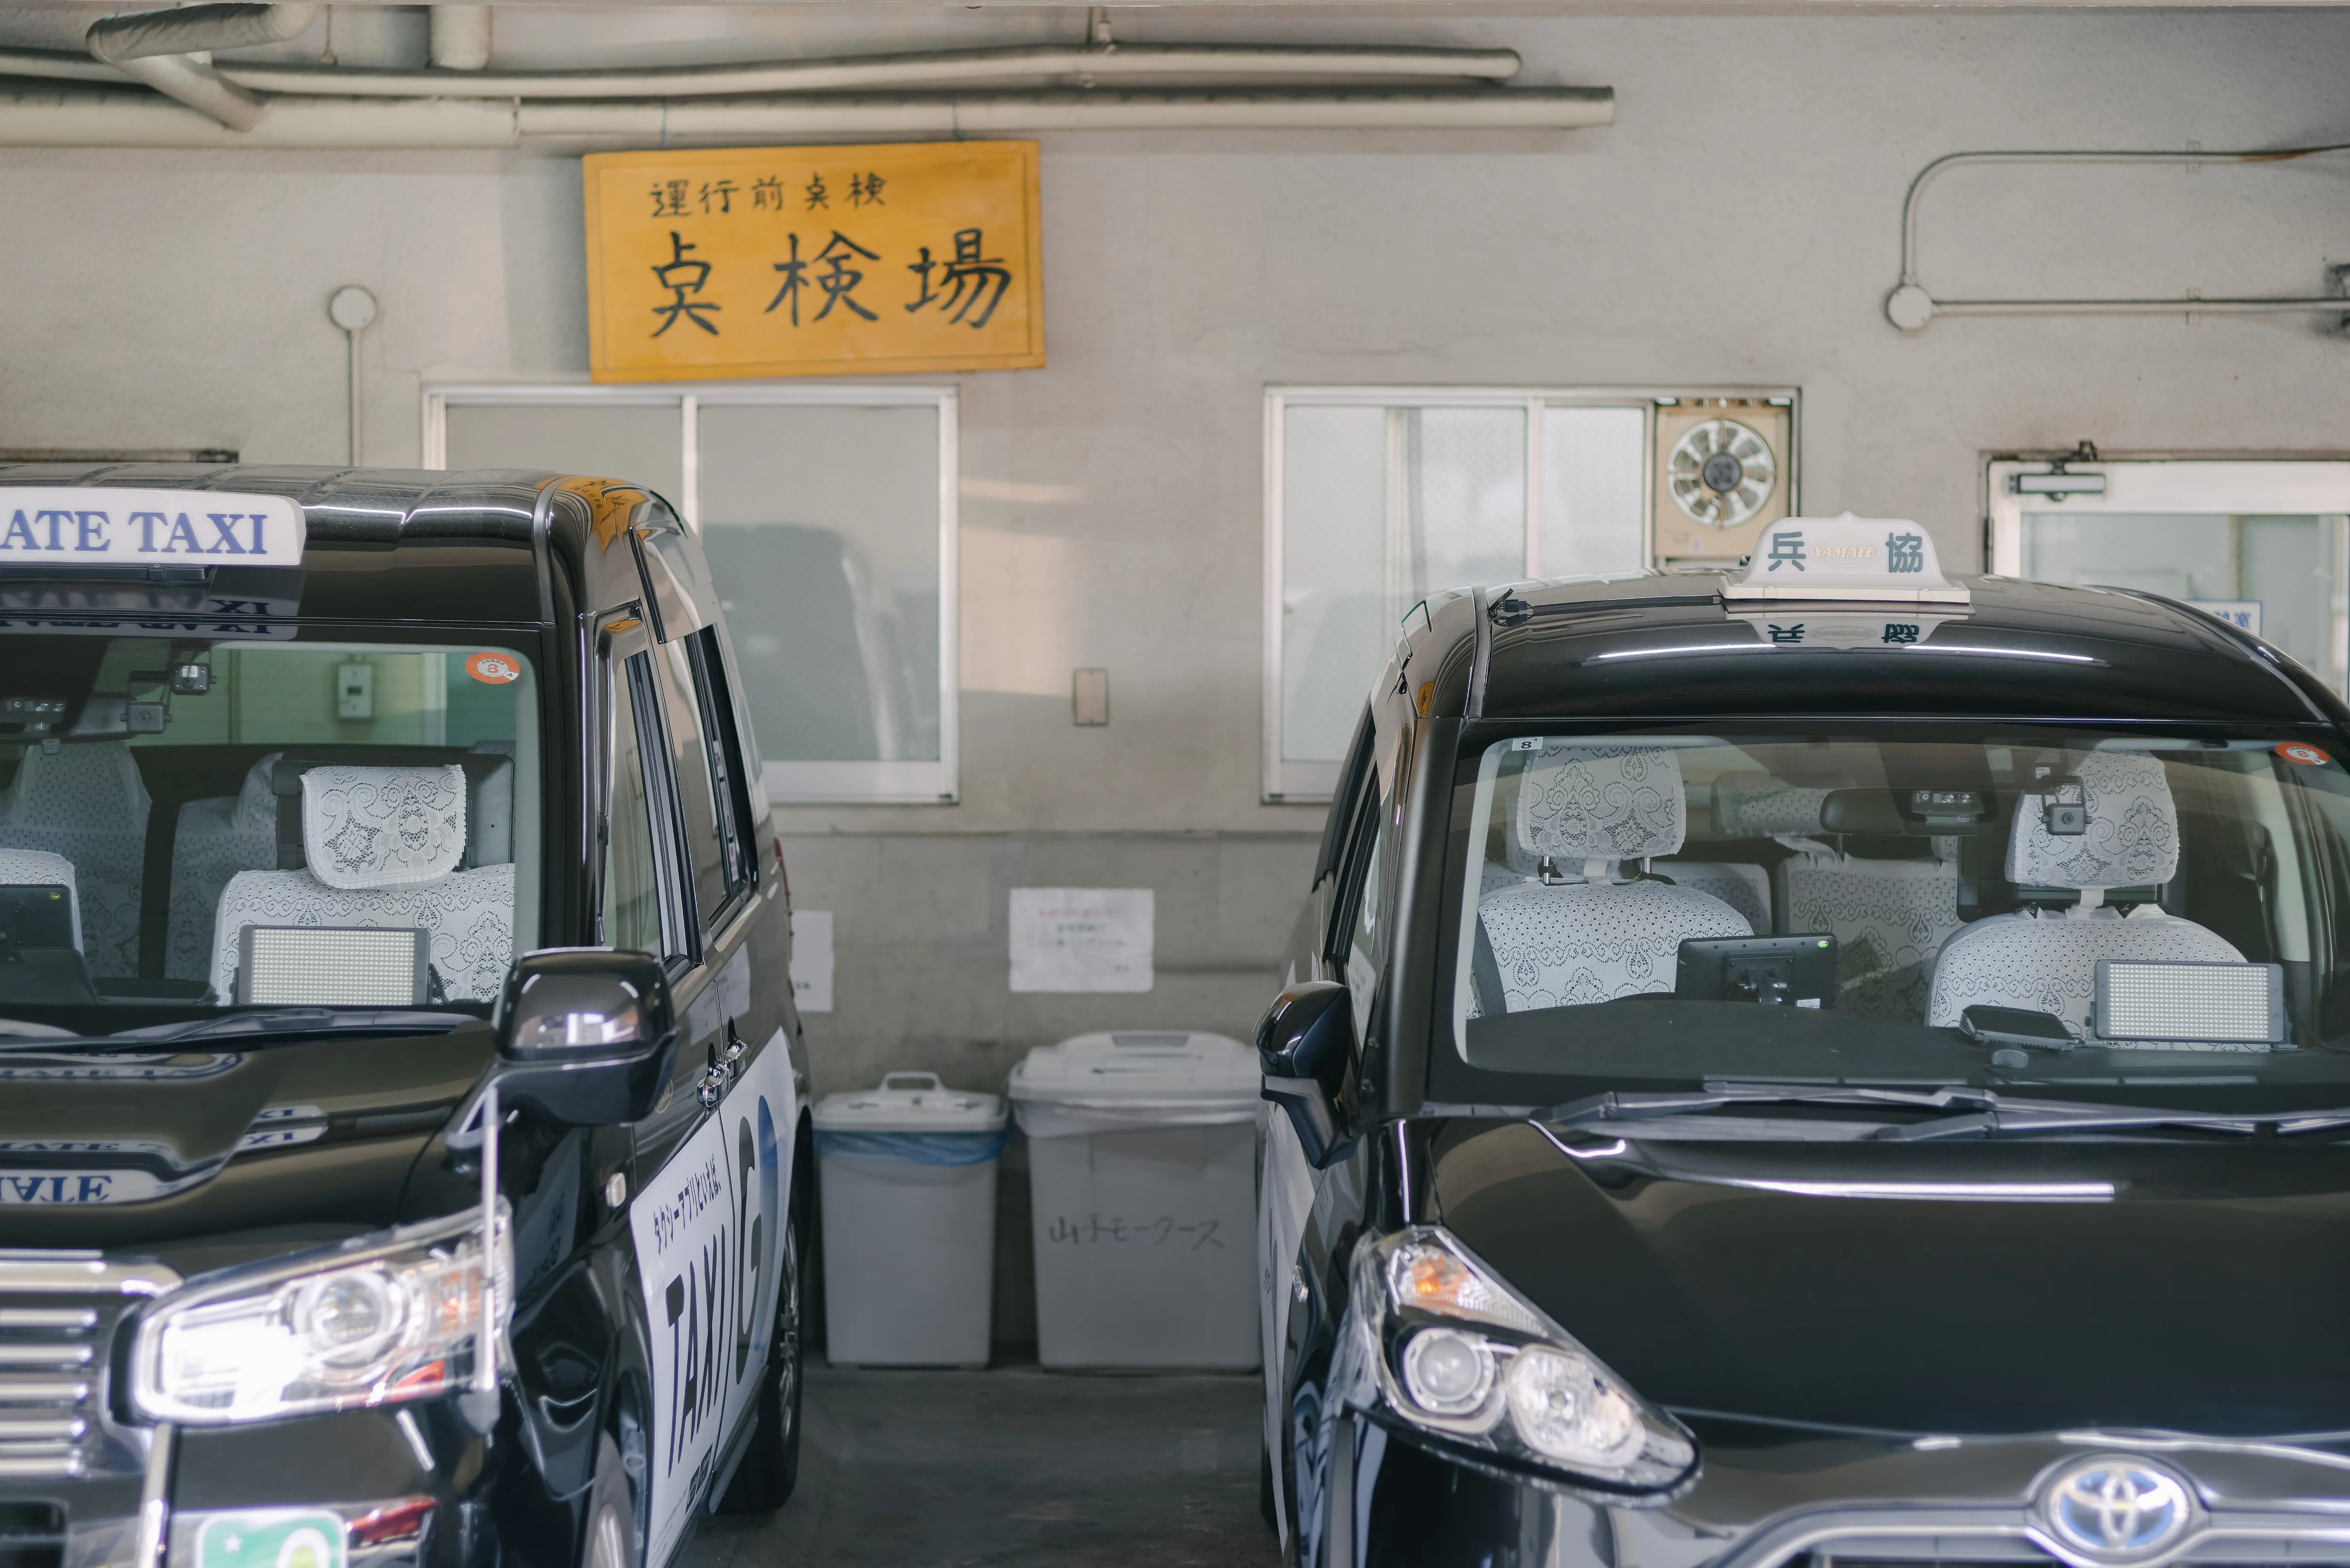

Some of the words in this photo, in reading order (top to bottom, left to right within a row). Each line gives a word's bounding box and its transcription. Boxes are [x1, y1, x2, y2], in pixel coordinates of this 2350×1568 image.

[128, 512, 268, 554] TAXI
[1768, 531, 1806, 572] 兵
[1814, 546, 1876, 558] YAMATE
[1886, 532, 1923, 573] 協
[487, 664, 499, 674] 8
[666, 1223, 725, 1480] TAXI
